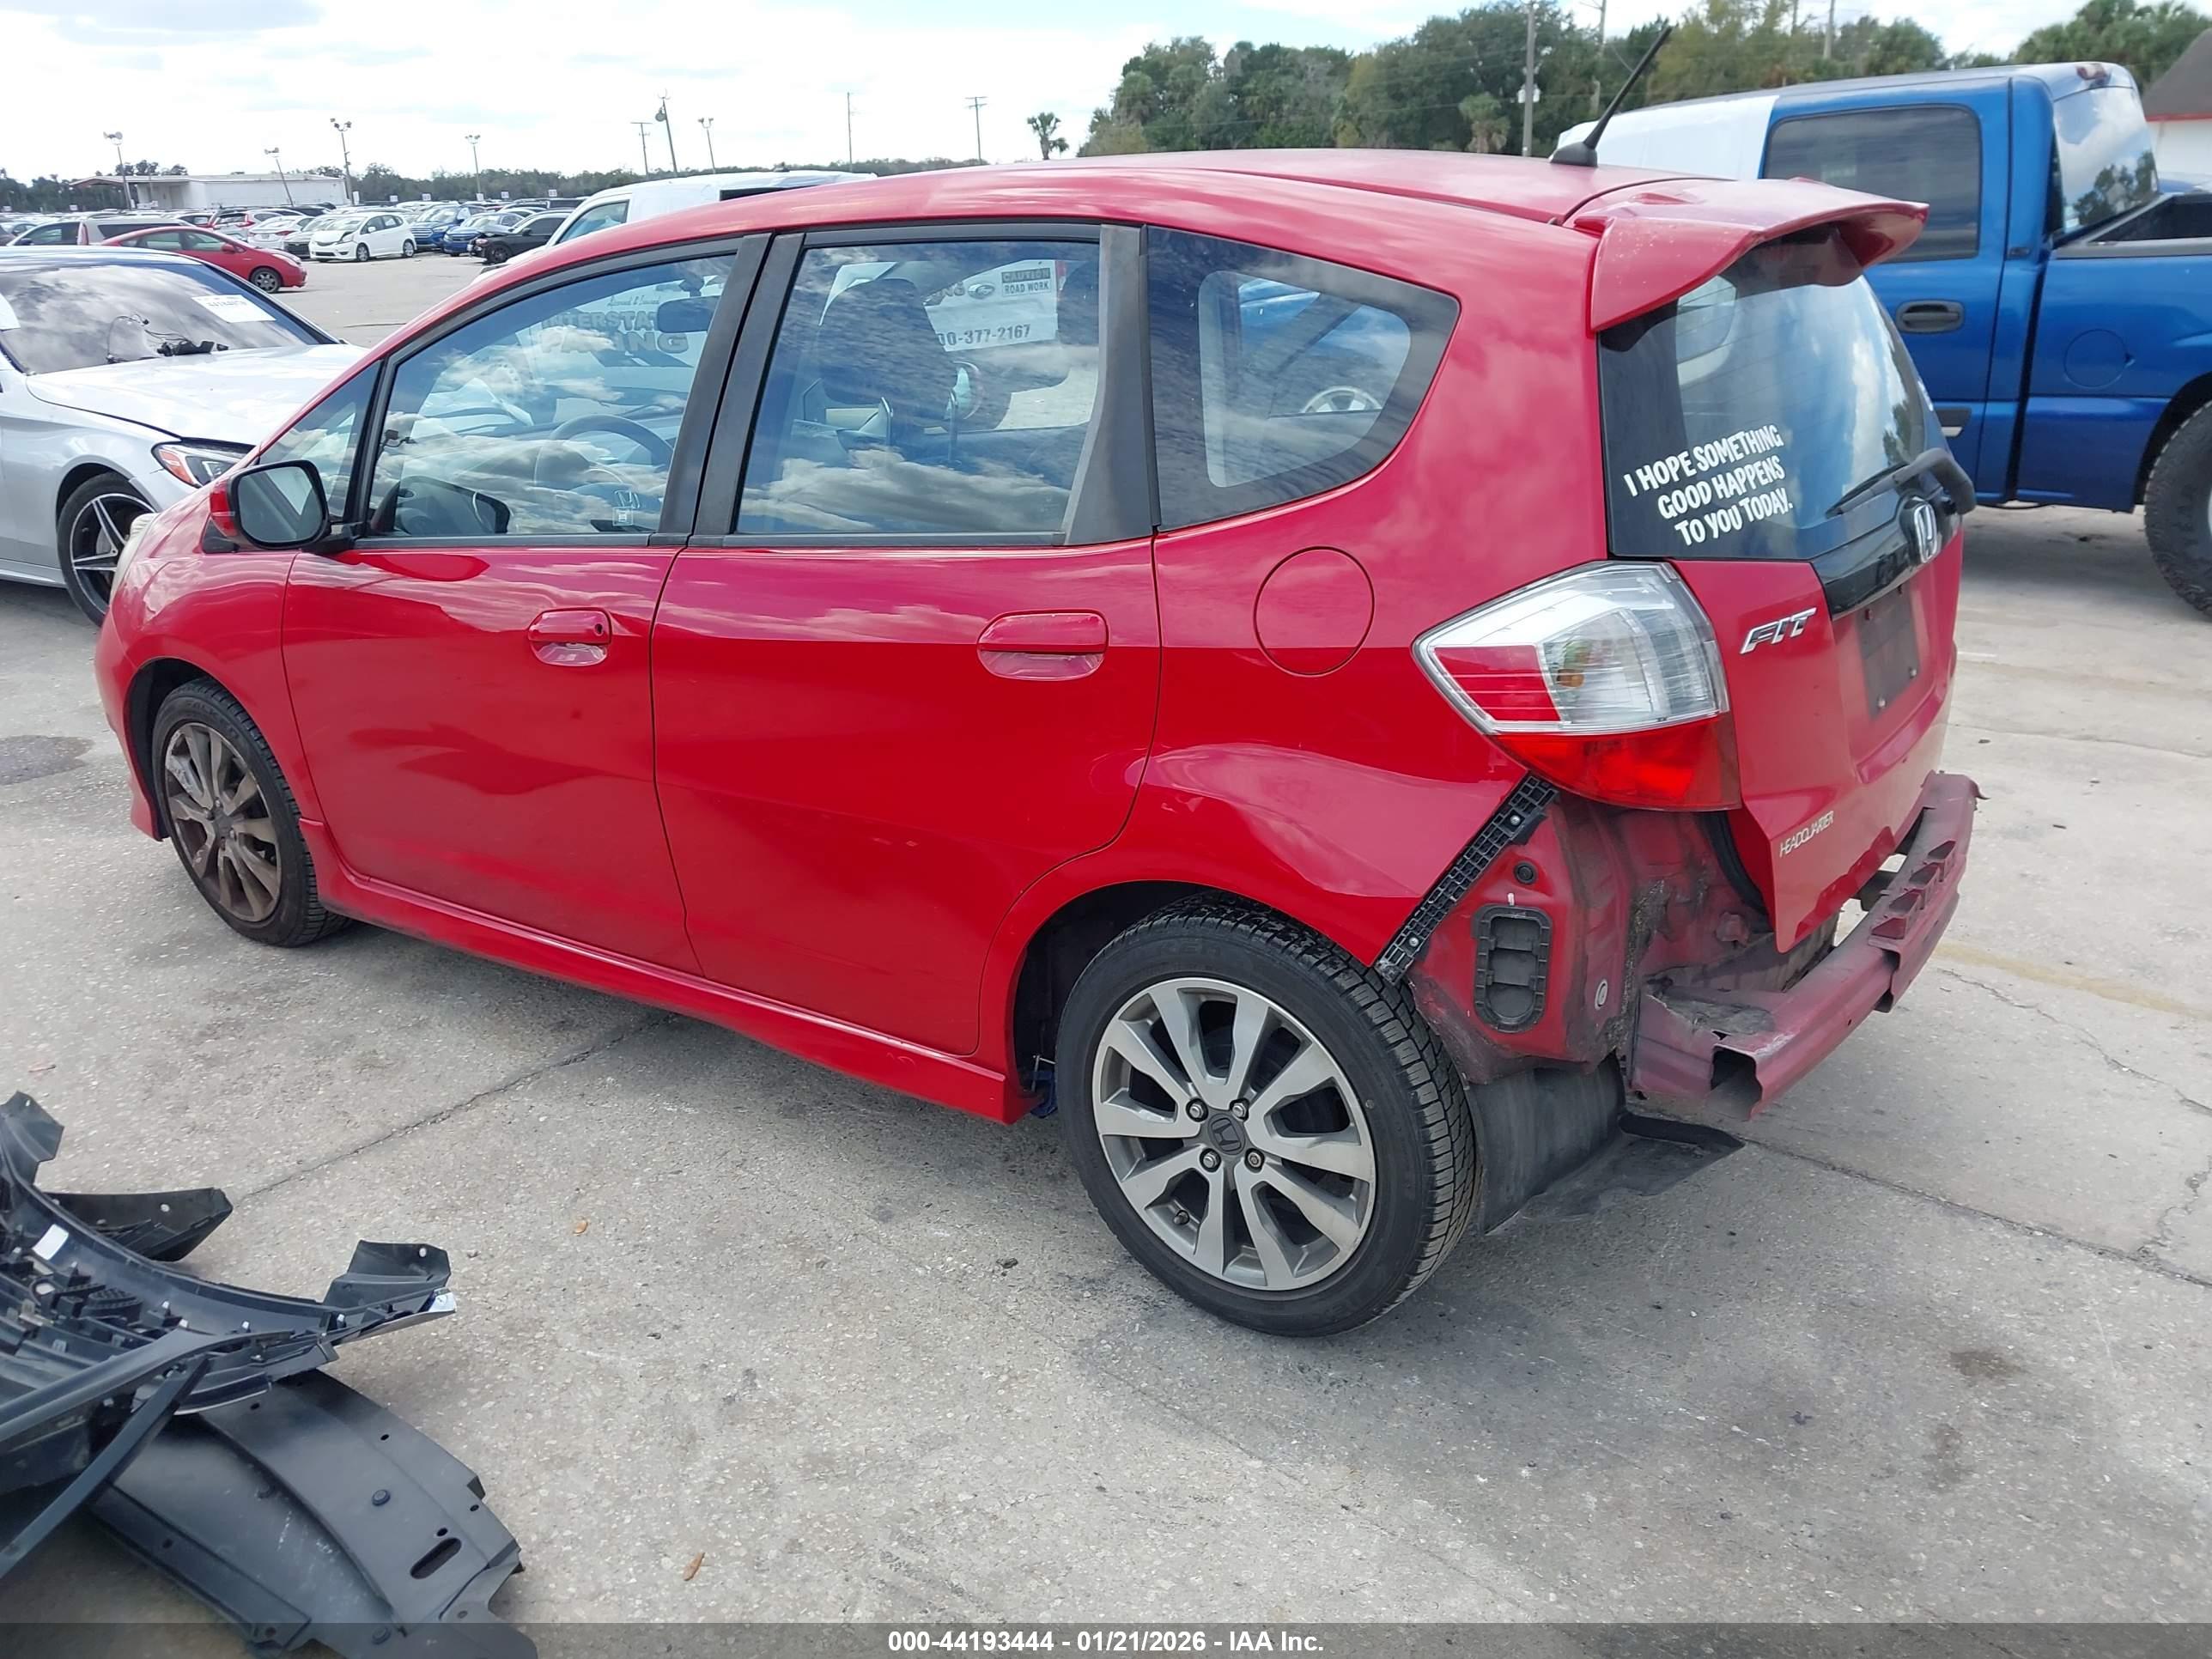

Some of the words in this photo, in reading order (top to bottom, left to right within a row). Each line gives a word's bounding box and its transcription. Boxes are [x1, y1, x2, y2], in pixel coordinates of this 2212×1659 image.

[1002, 269, 1050, 283] CAUTION
[1005, 283, 1025, 295] ROAD
[1027, 280, 1049, 293] WORK
[1623, 473, 1638, 497] I
[1636, 451, 1697, 491] HOPE
[1692, 424, 1784, 471] SOMETHING
[1658, 481, 1712, 520] GOOD
[1711, 455, 1786, 500] HAPPENS
[1674, 519, 1706, 546] TO
[1704, 505, 1743, 539] YOU
[1738, 487, 1794, 522] TODAY.
[1740, 606, 1817, 654] FIT
[1779, 810, 1834, 859] HEADQUARTER
